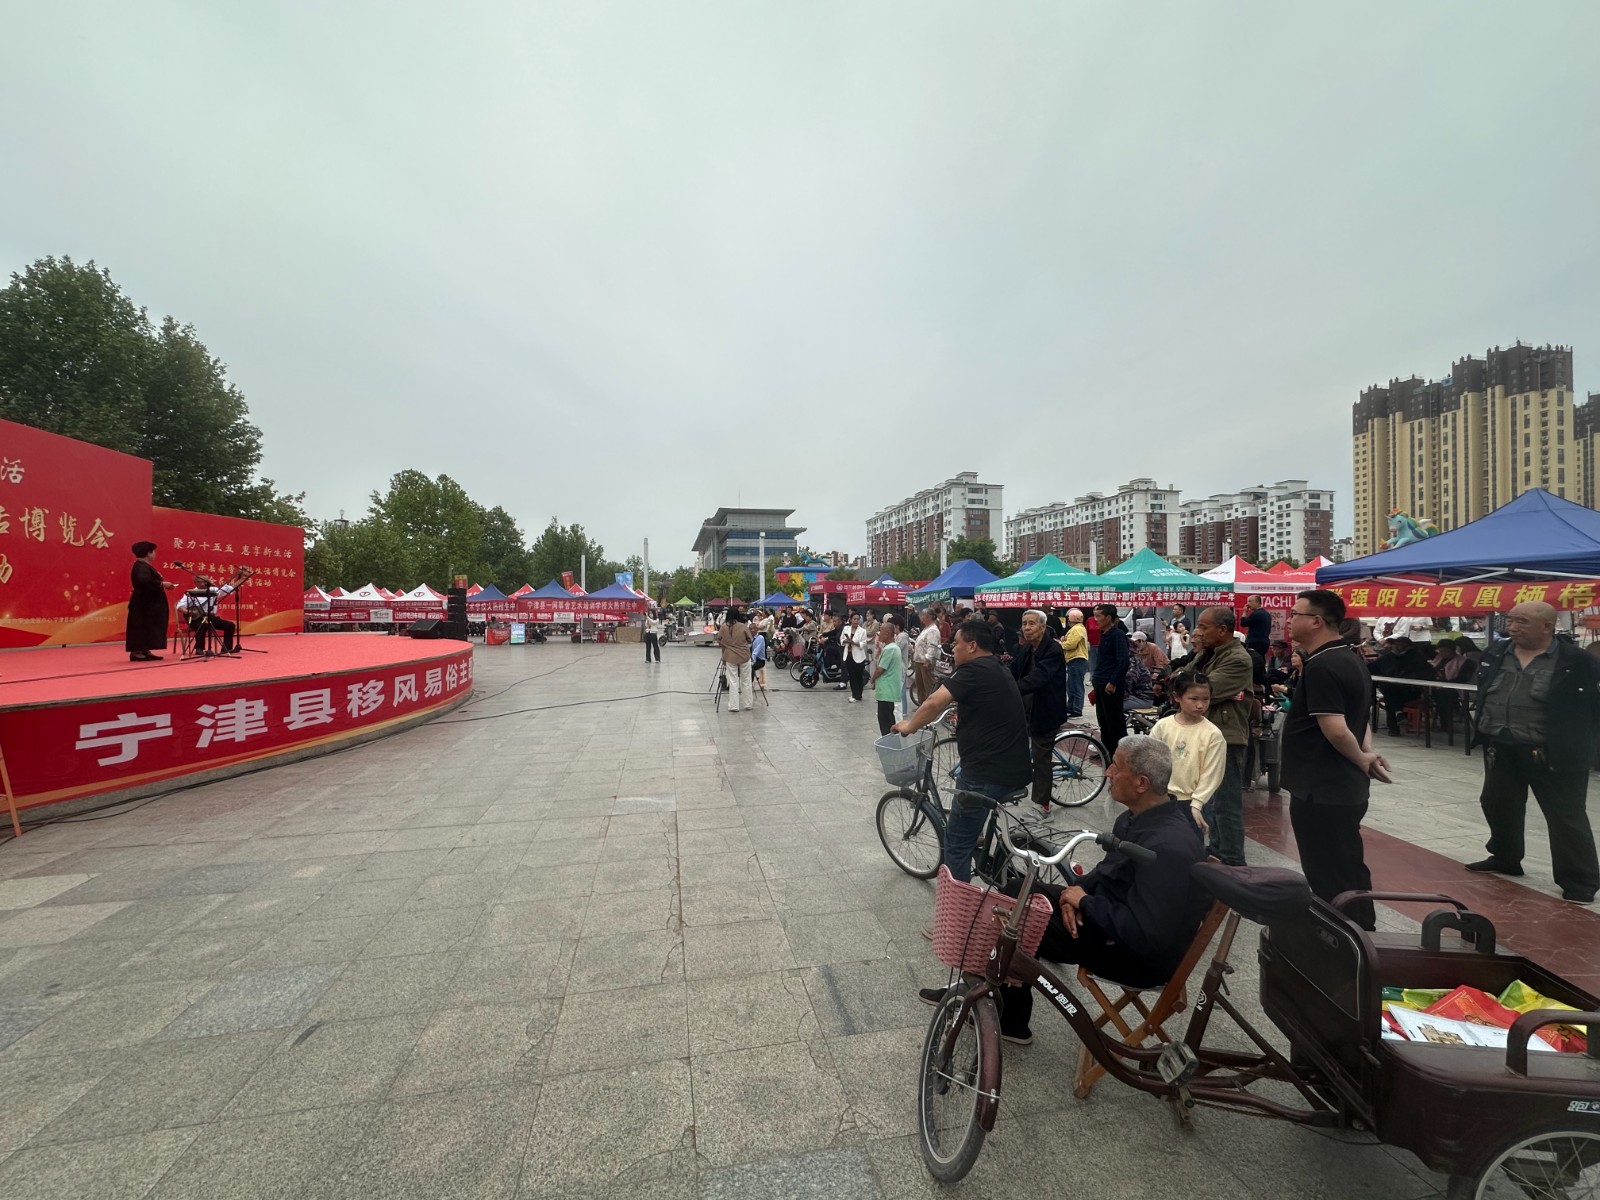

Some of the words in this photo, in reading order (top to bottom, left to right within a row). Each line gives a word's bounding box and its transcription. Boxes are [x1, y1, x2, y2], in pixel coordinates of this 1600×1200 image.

[173, 537, 235, 553] 聚力十五五
[241, 544, 292, 558] 惠享新生活
[1030, 592, 1062, 601] 海信家电
